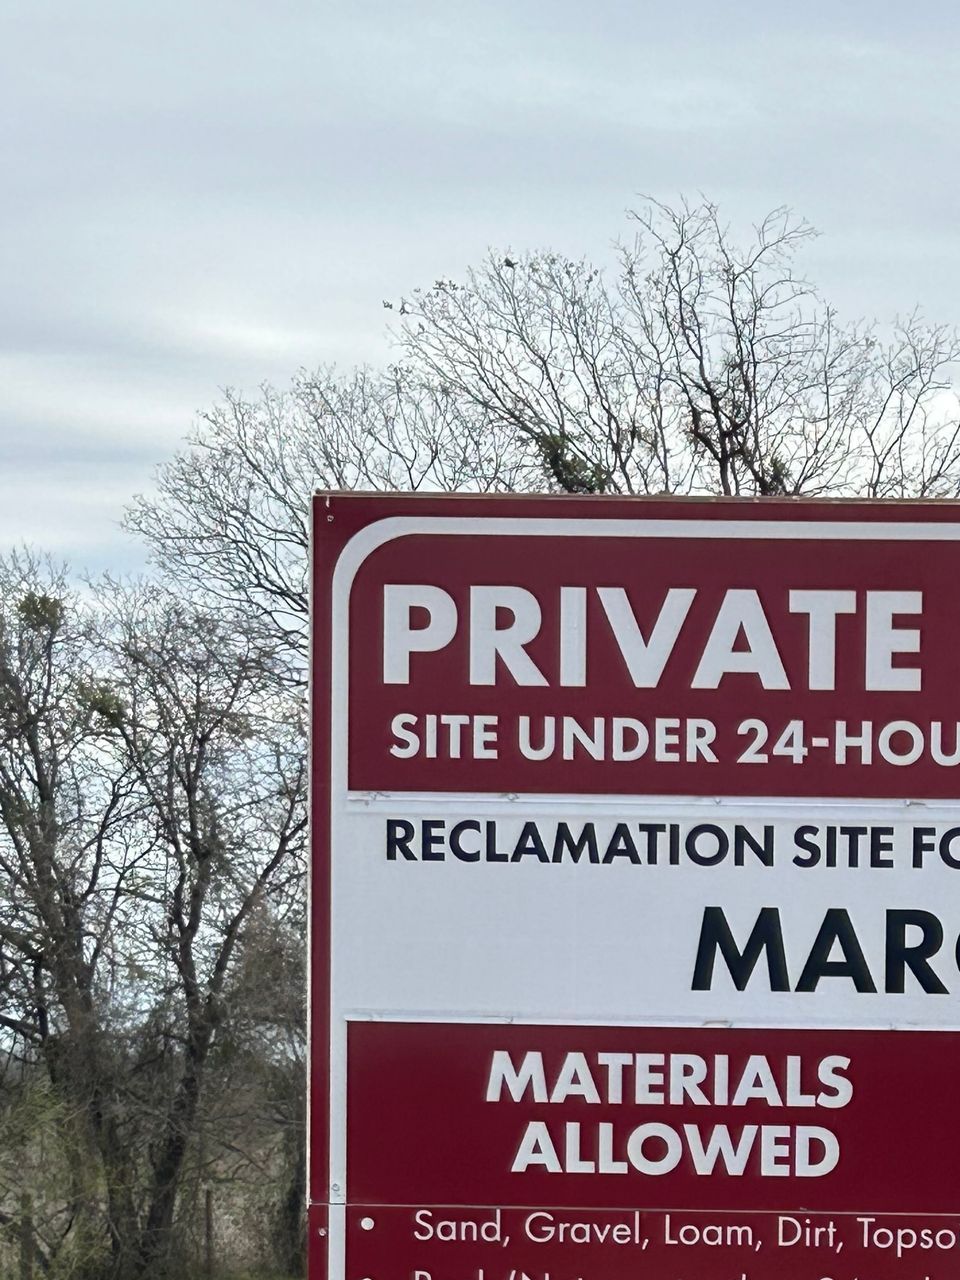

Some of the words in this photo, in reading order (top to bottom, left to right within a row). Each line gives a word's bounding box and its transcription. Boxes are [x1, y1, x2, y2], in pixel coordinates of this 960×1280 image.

[383, 583, 923, 692] PRIVATE
[389, 713, 499, 760] SITE
[518, 715, 720, 763] UNDER
[386, 818, 775, 867] RECLAMATION
[792, 824, 895, 869] SITE
[485, 1050, 854, 1109] MATERIALS
[510, 1121, 840, 1177] ALLOWED
[413, 1208, 510, 1248] Sand,
[524, 1210, 649, 1250] Gravel,
[664, 1214, 762, 1252] Loam,
[778, 1215, 844, 1254] Dirt,
